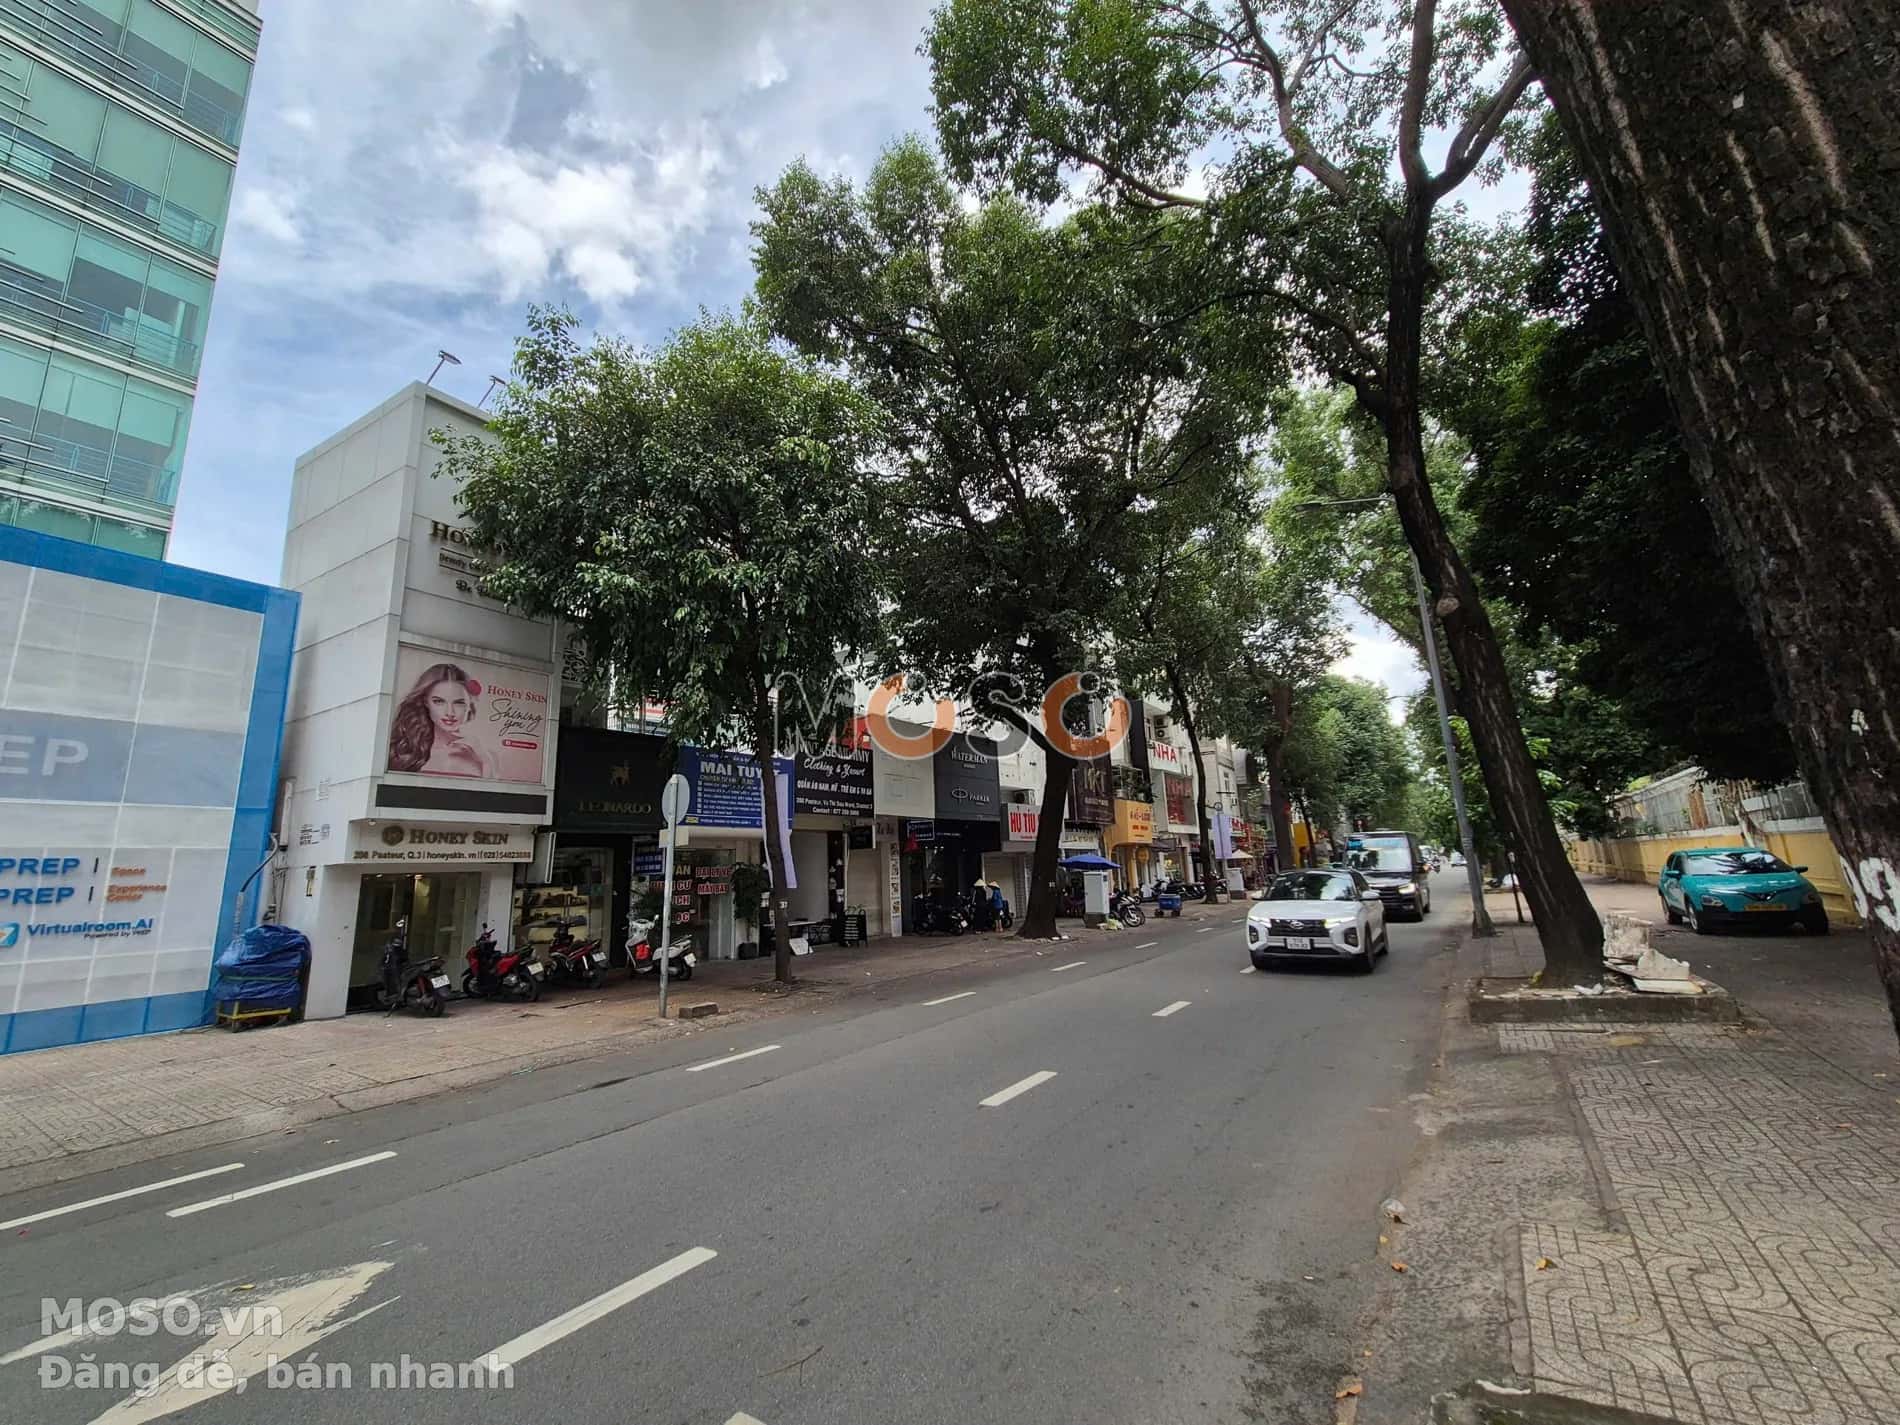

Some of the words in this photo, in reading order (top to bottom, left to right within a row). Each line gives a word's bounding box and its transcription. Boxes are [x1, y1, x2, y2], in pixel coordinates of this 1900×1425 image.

[488, 685, 522, 700] HONEY
[489, 698, 543, 732] Shining
[700, 760, 732, 776] MAI
[408, 829, 467, 845] HONEY
[472, 830, 509, 845] SKIN
[0, 857, 80, 875] PREP
